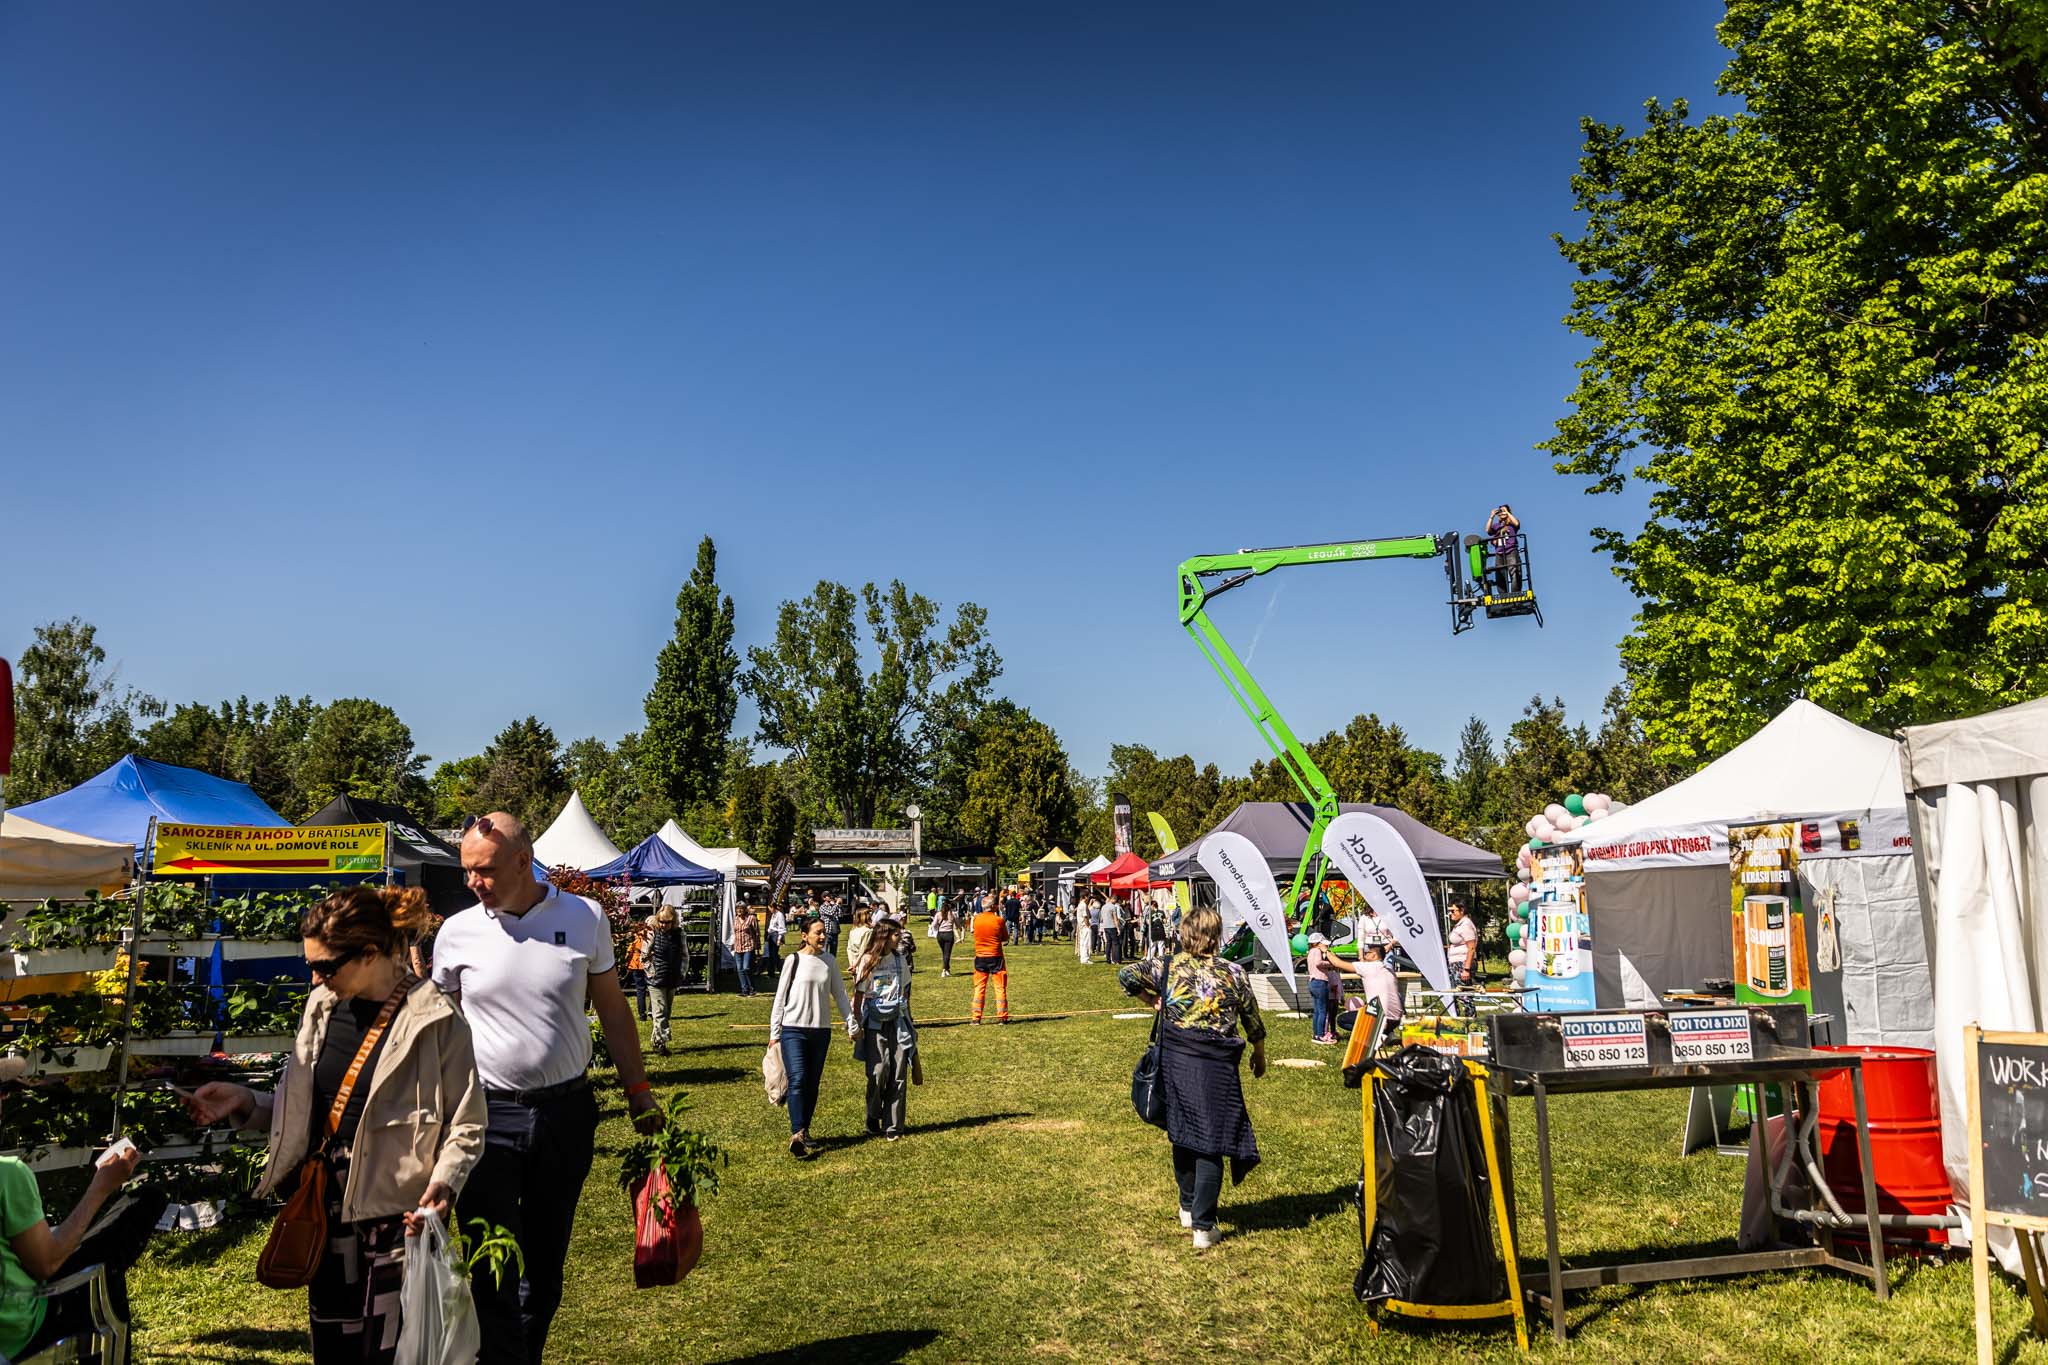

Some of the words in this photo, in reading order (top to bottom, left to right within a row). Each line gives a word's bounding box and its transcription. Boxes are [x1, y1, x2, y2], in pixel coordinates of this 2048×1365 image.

[162, 827, 242, 840] SAMOZBER
[297, 828, 304, 838] V
[308, 828, 381, 838] BRATISLAVE
[186, 841, 234, 850] SKLENÍK
[235, 842, 251, 850] NA
[255, 842, 274, 850] UL.
[276, 840, 327, 850] DOMOVÉ
[330, 841, 359, 850] ROLE
[1566, 1024, 1585, 1034] TOI
[1588, 1023, 1607, 1034] TOI
[1608, 1023, 1616, 1032] &
[1618, 1022, 1642, 1032] DIXI
[1672, 1020, 1692, 1030] TOI
[1695, 1019, 1713, 1029] TOI
[1715, 1018, 1722, 1028] &
[1724, 1017, 1746, 1028] DIXI
[1566, 1050, 1594, 1062] 0850
[1599, 1049, 1620, 1060] 850
[1624, 1048, 1645, 1059] 123
[1674, 1044, 1702, 1056] 0850
[1706, 1044, 1726, 1055] 850
[1730, 1042, 1749, 1054] 123
